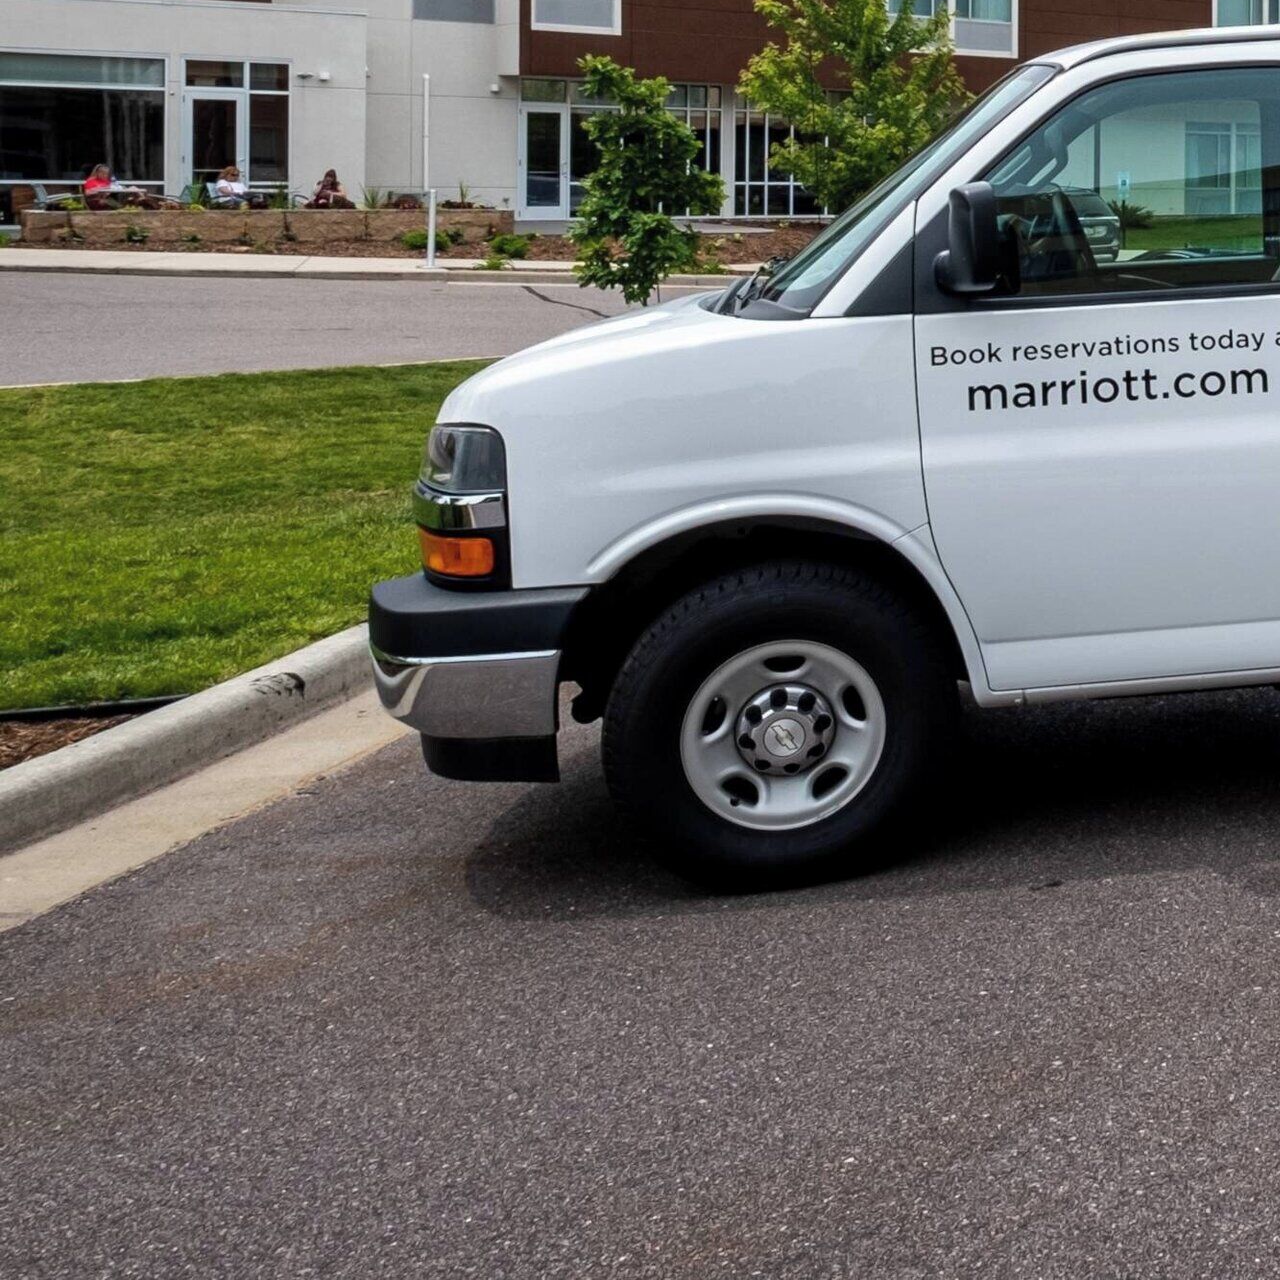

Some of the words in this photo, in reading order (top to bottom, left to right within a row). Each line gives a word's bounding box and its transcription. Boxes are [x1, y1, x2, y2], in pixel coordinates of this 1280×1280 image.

[930, 342, 1003, 367] Book
[1011, 334, 1180, 362] reservations
[1188, 328, 1266, 353] today
[967, 367, 1270, 412] marriott.com
